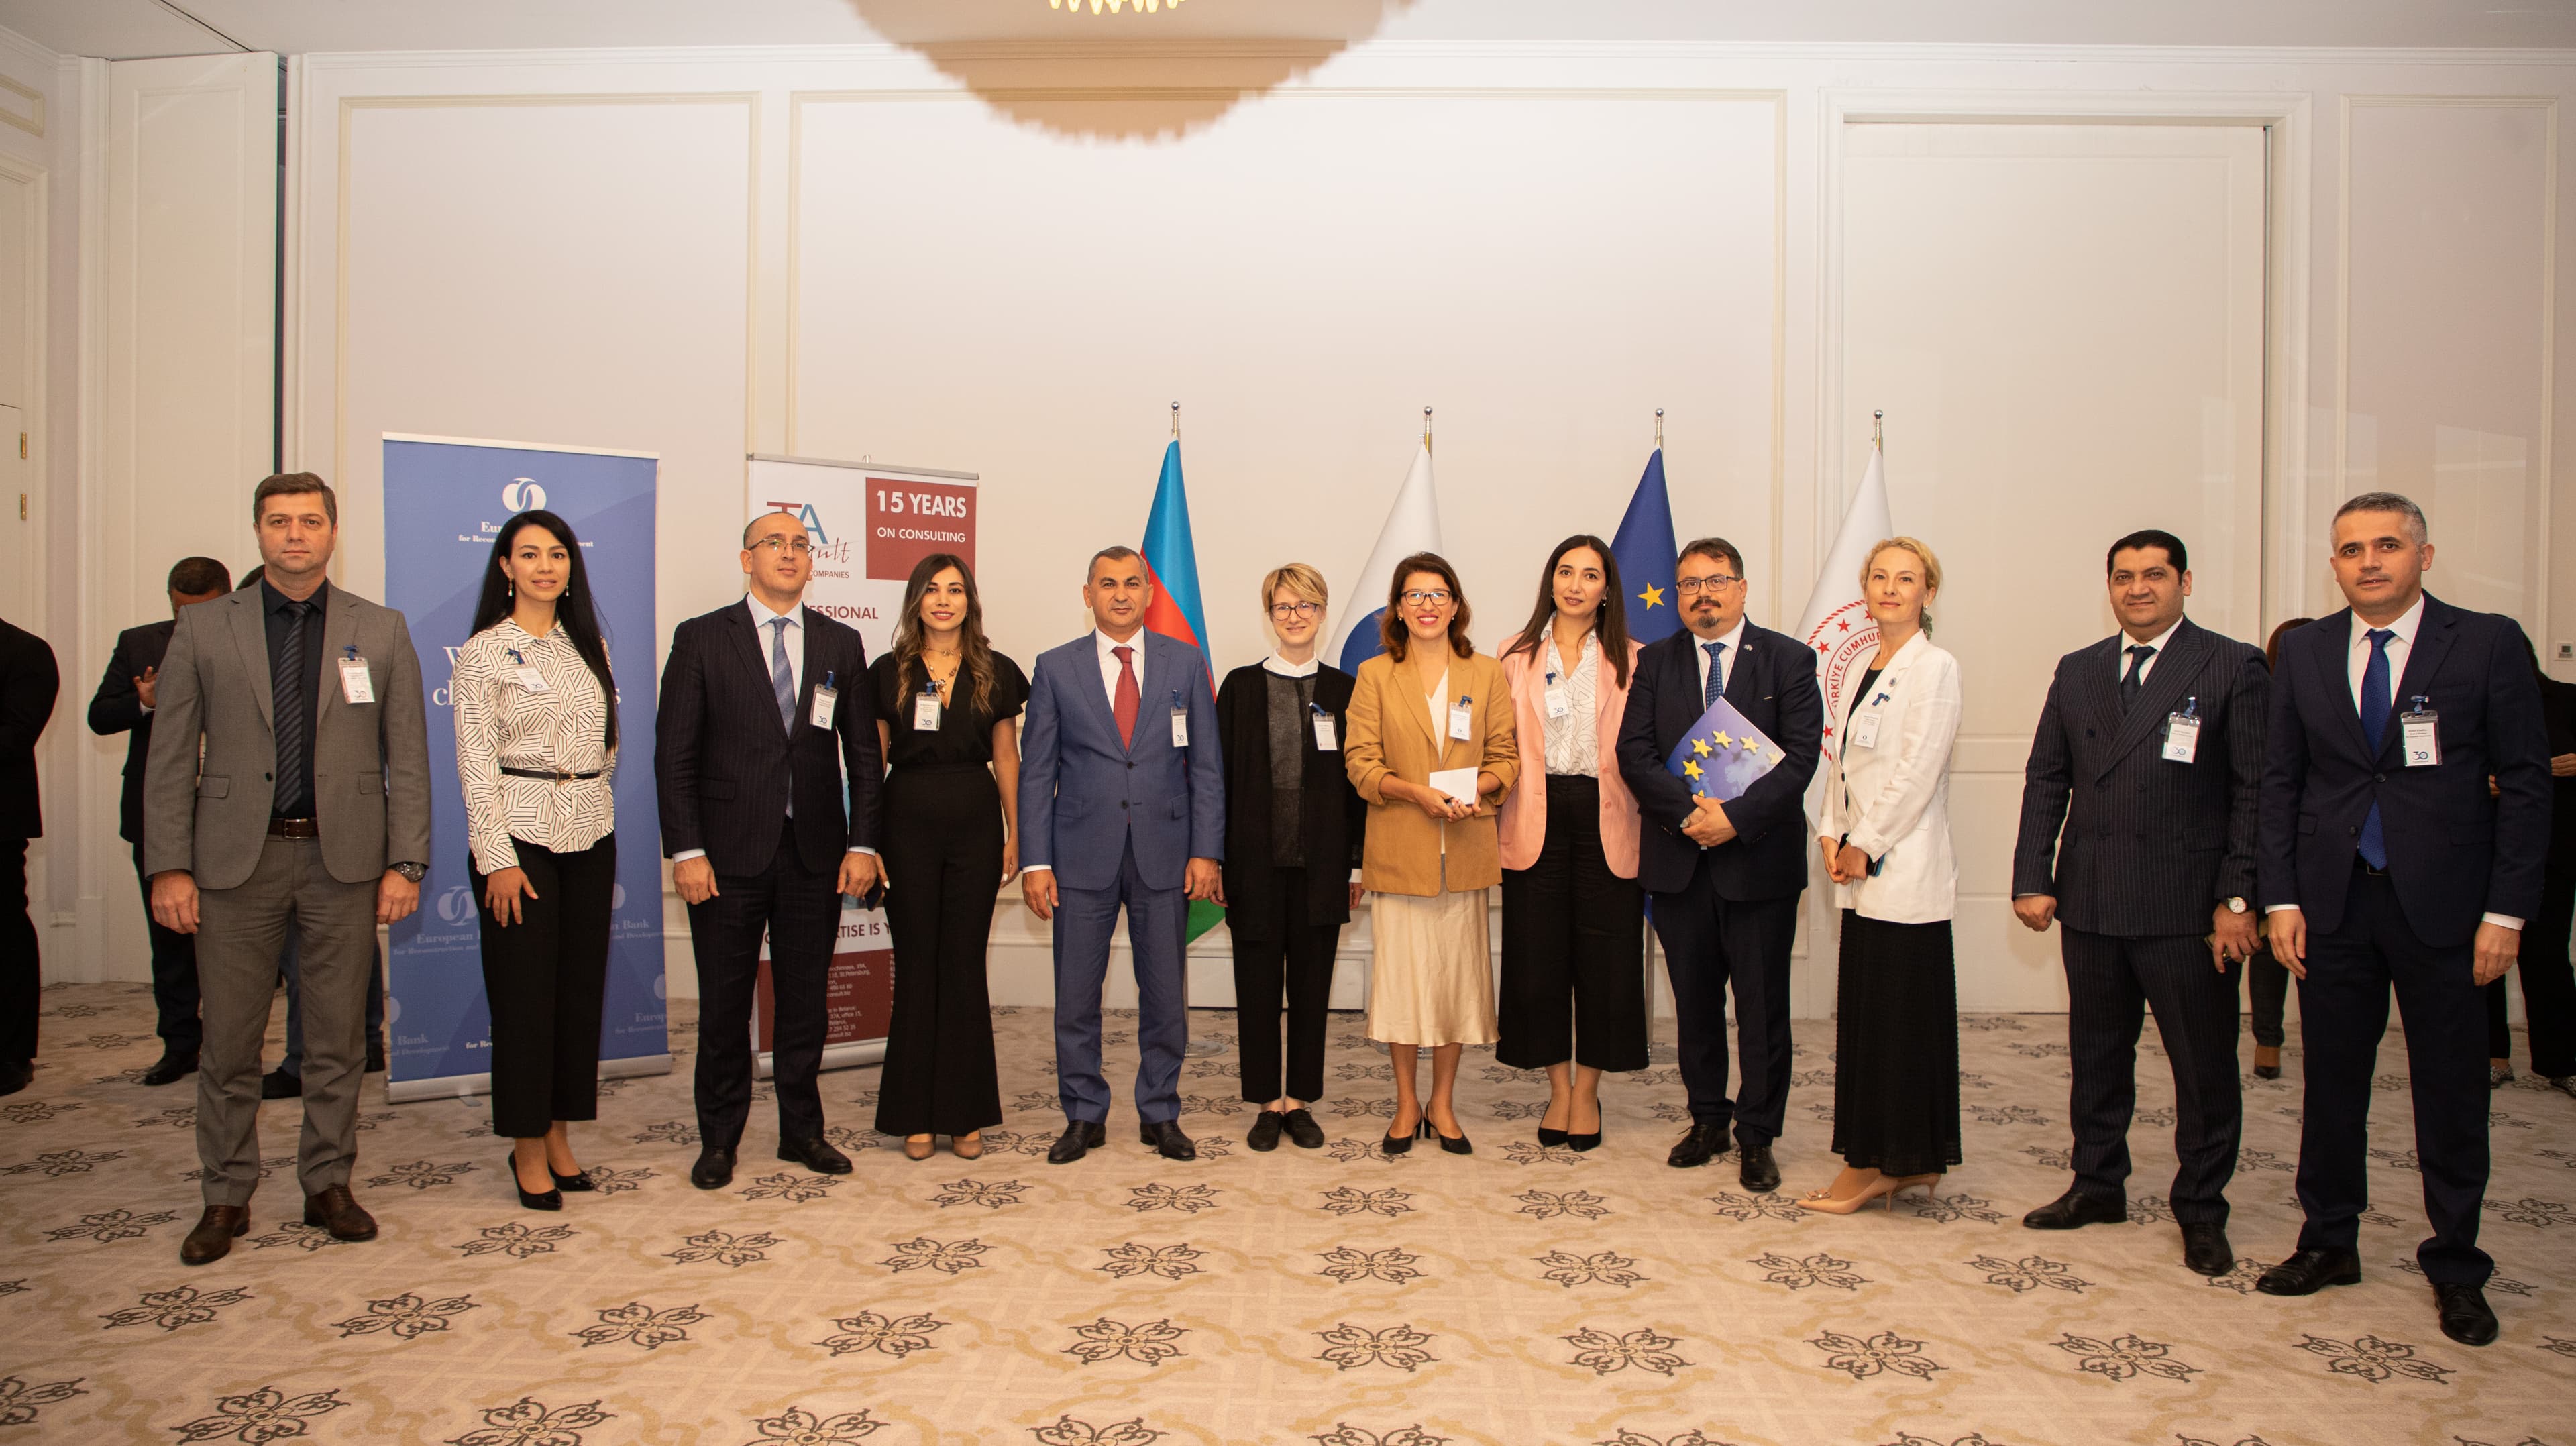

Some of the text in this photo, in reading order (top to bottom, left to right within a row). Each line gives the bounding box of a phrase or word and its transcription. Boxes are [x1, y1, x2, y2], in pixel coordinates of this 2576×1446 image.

[877, 490, 967, 518] 15 YEARS
[877, 527, 966, 543] ON CONSULTING
[806, 605, 879, 619] SSIONAL
[2413, 751, 2428, 760] 30
[869, 923, 880, 936] IS
[416, 933, 473, 945] European
[466, 1042, 478, 1050] for
